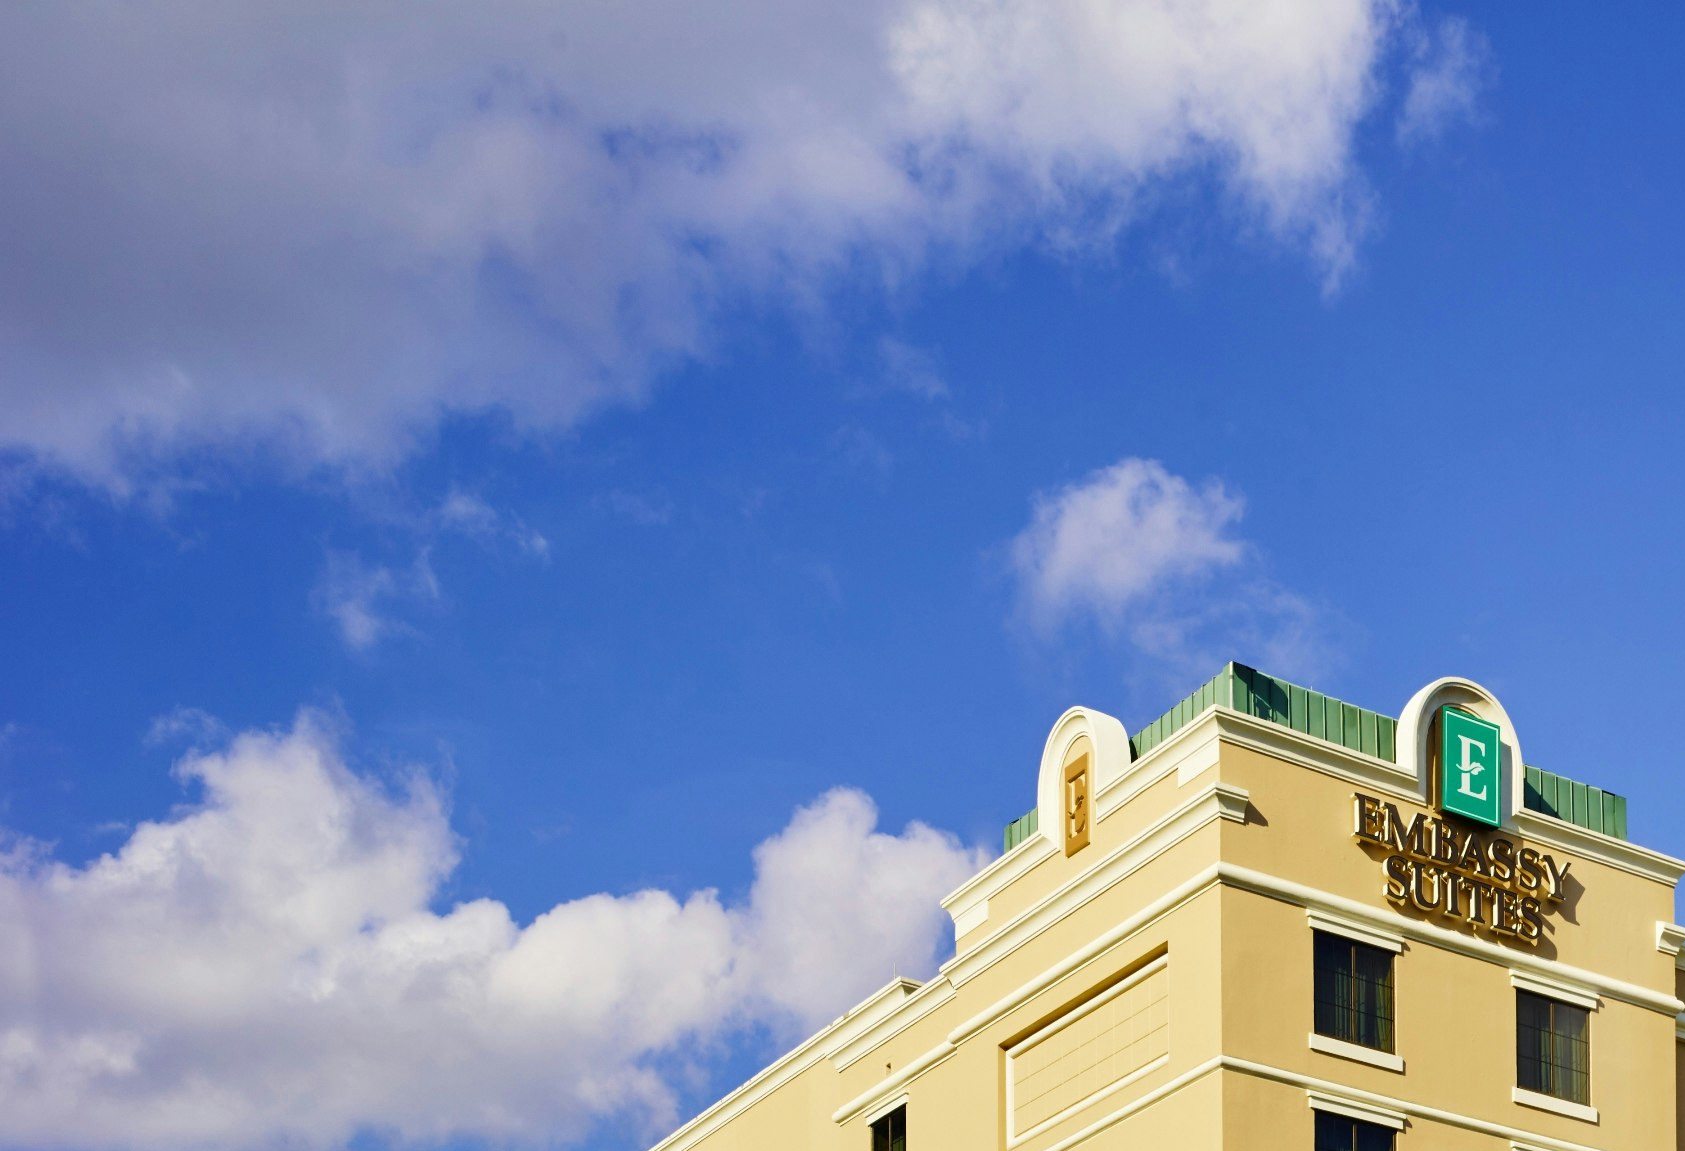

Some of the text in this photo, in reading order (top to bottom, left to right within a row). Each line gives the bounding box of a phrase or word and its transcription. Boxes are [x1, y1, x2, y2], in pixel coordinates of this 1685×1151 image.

[1456, 734, 1487, 801] E
[1351, 792, 1571, 901] EMBASSY
[1382, 854, 1543, 943] SUITES
